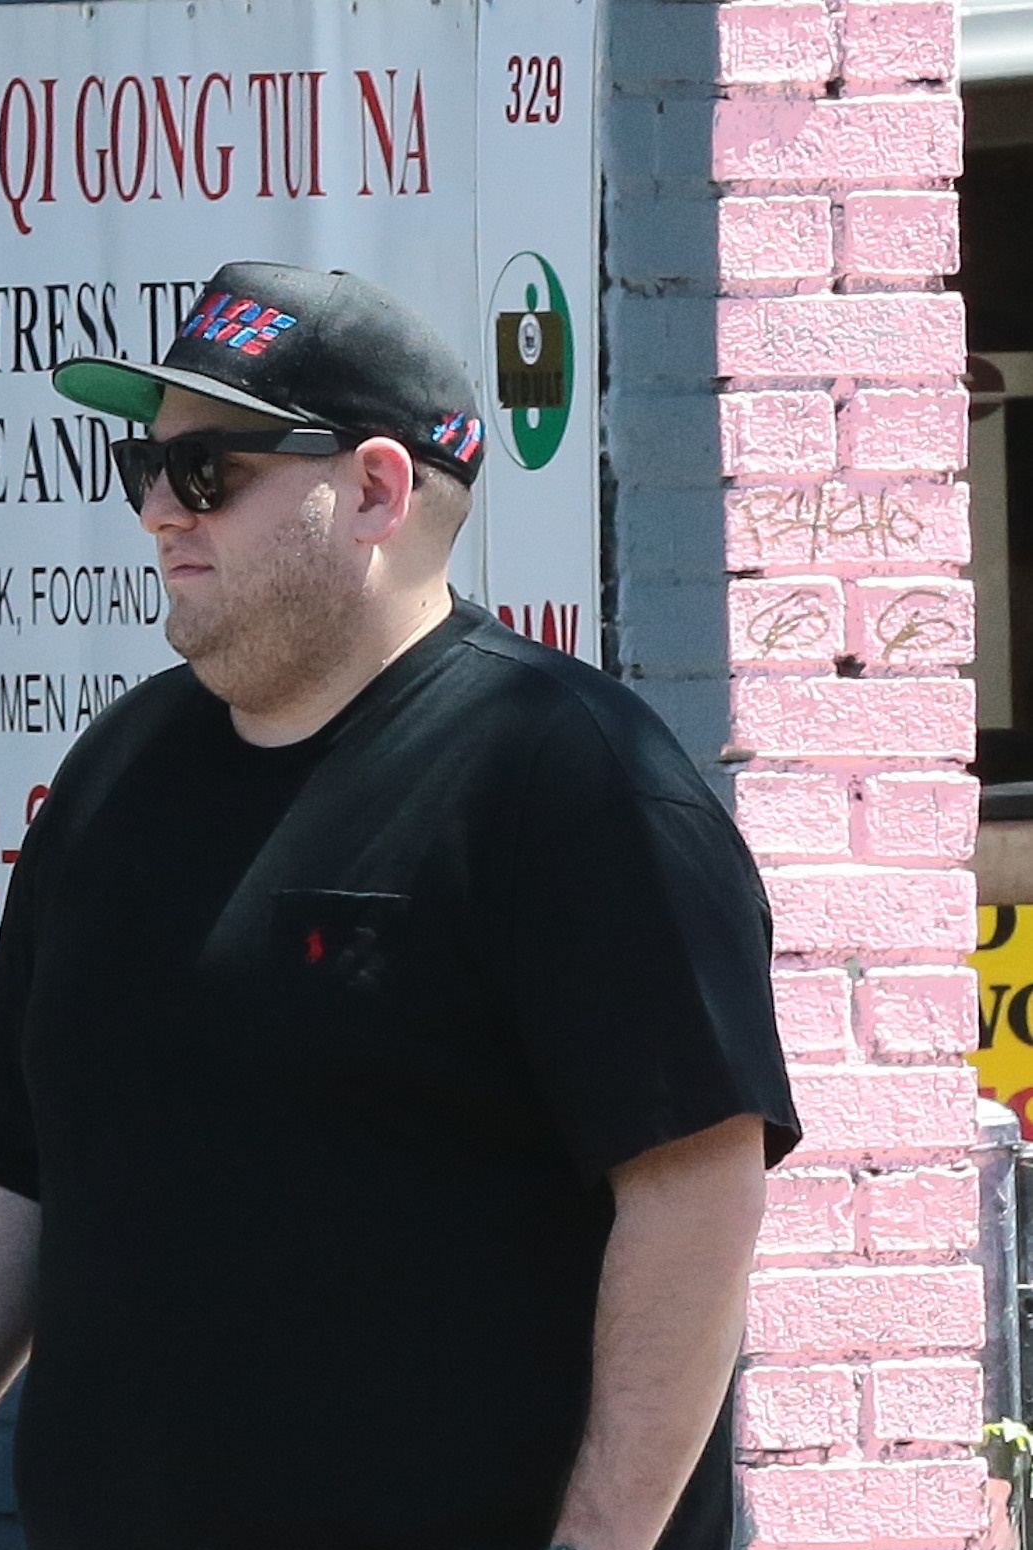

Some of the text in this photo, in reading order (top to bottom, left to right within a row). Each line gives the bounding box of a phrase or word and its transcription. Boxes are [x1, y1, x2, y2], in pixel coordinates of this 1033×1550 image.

[507, 56, 562, 124] 329
[75, 72, 233, 203] GONG
[249, 71, 325, 198] TUI
[354, 69, 430, 196] NA
[18, 414, 112, 504] AND
[0, 674, 66, 733] MEN
